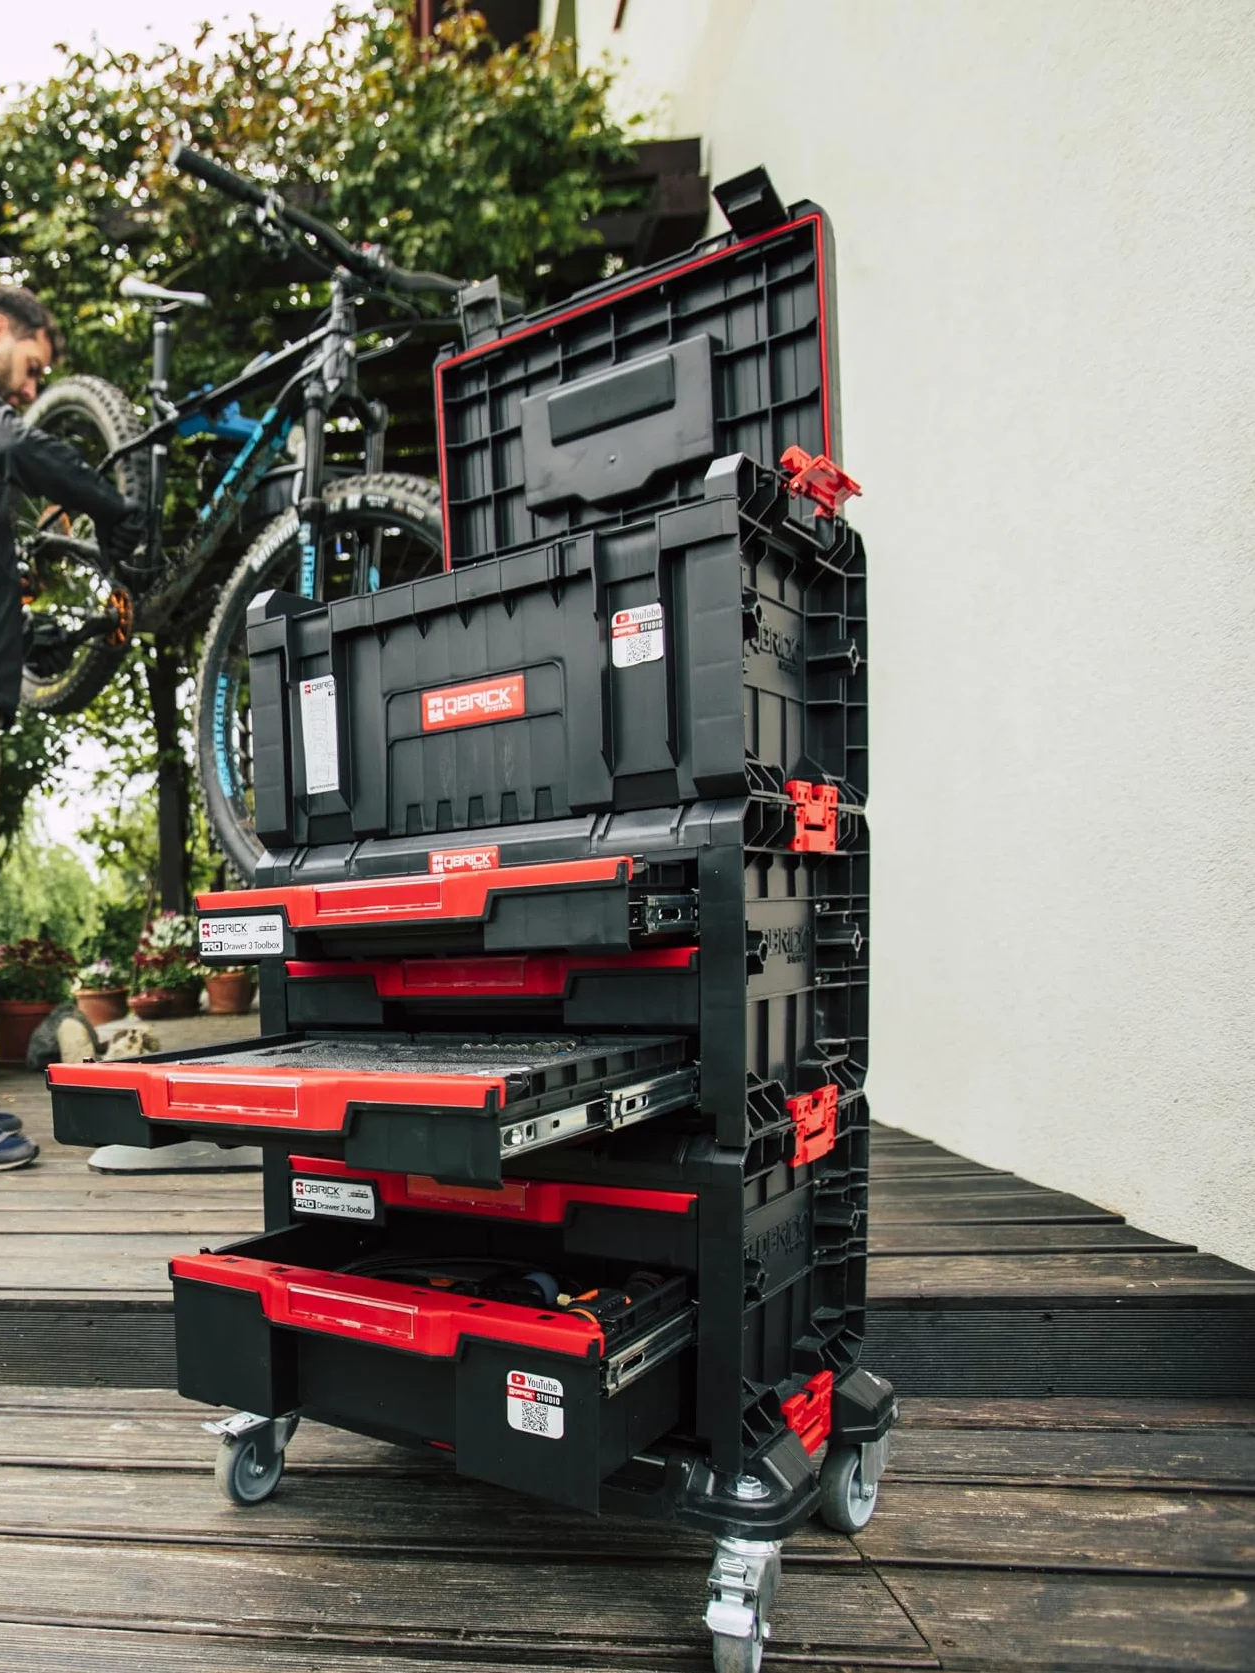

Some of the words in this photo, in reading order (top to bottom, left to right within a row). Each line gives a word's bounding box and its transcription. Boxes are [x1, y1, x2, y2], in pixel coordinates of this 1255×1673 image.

[640, 619, 663, 632] STUDIO
[445, 687, 511, 715] QBRICK
[484, 702, 513, 713] SYSTEM
[444, 852, 492, 869] QBRICK
[211, 923, 248, 935] QBRICK
[201, 942, 221, 951] PRO
[224, 942, 247, 951] Drawer
[248, 941, 253, 950] 3
[255, 940, 280, 949] Toolbox
[305, 1184, 340, 1196] QBRICK
[295, 1199, 315, 1208] PRO
[317, 1201, 339, 1211] Drawer
[341, 1204, 345, 1212] 2
[346, 1205, 371, 1214] Toolbox
[527, 1376, 558, 1393] YouTube
[536, 1393, 560, 1405] STUDIO
